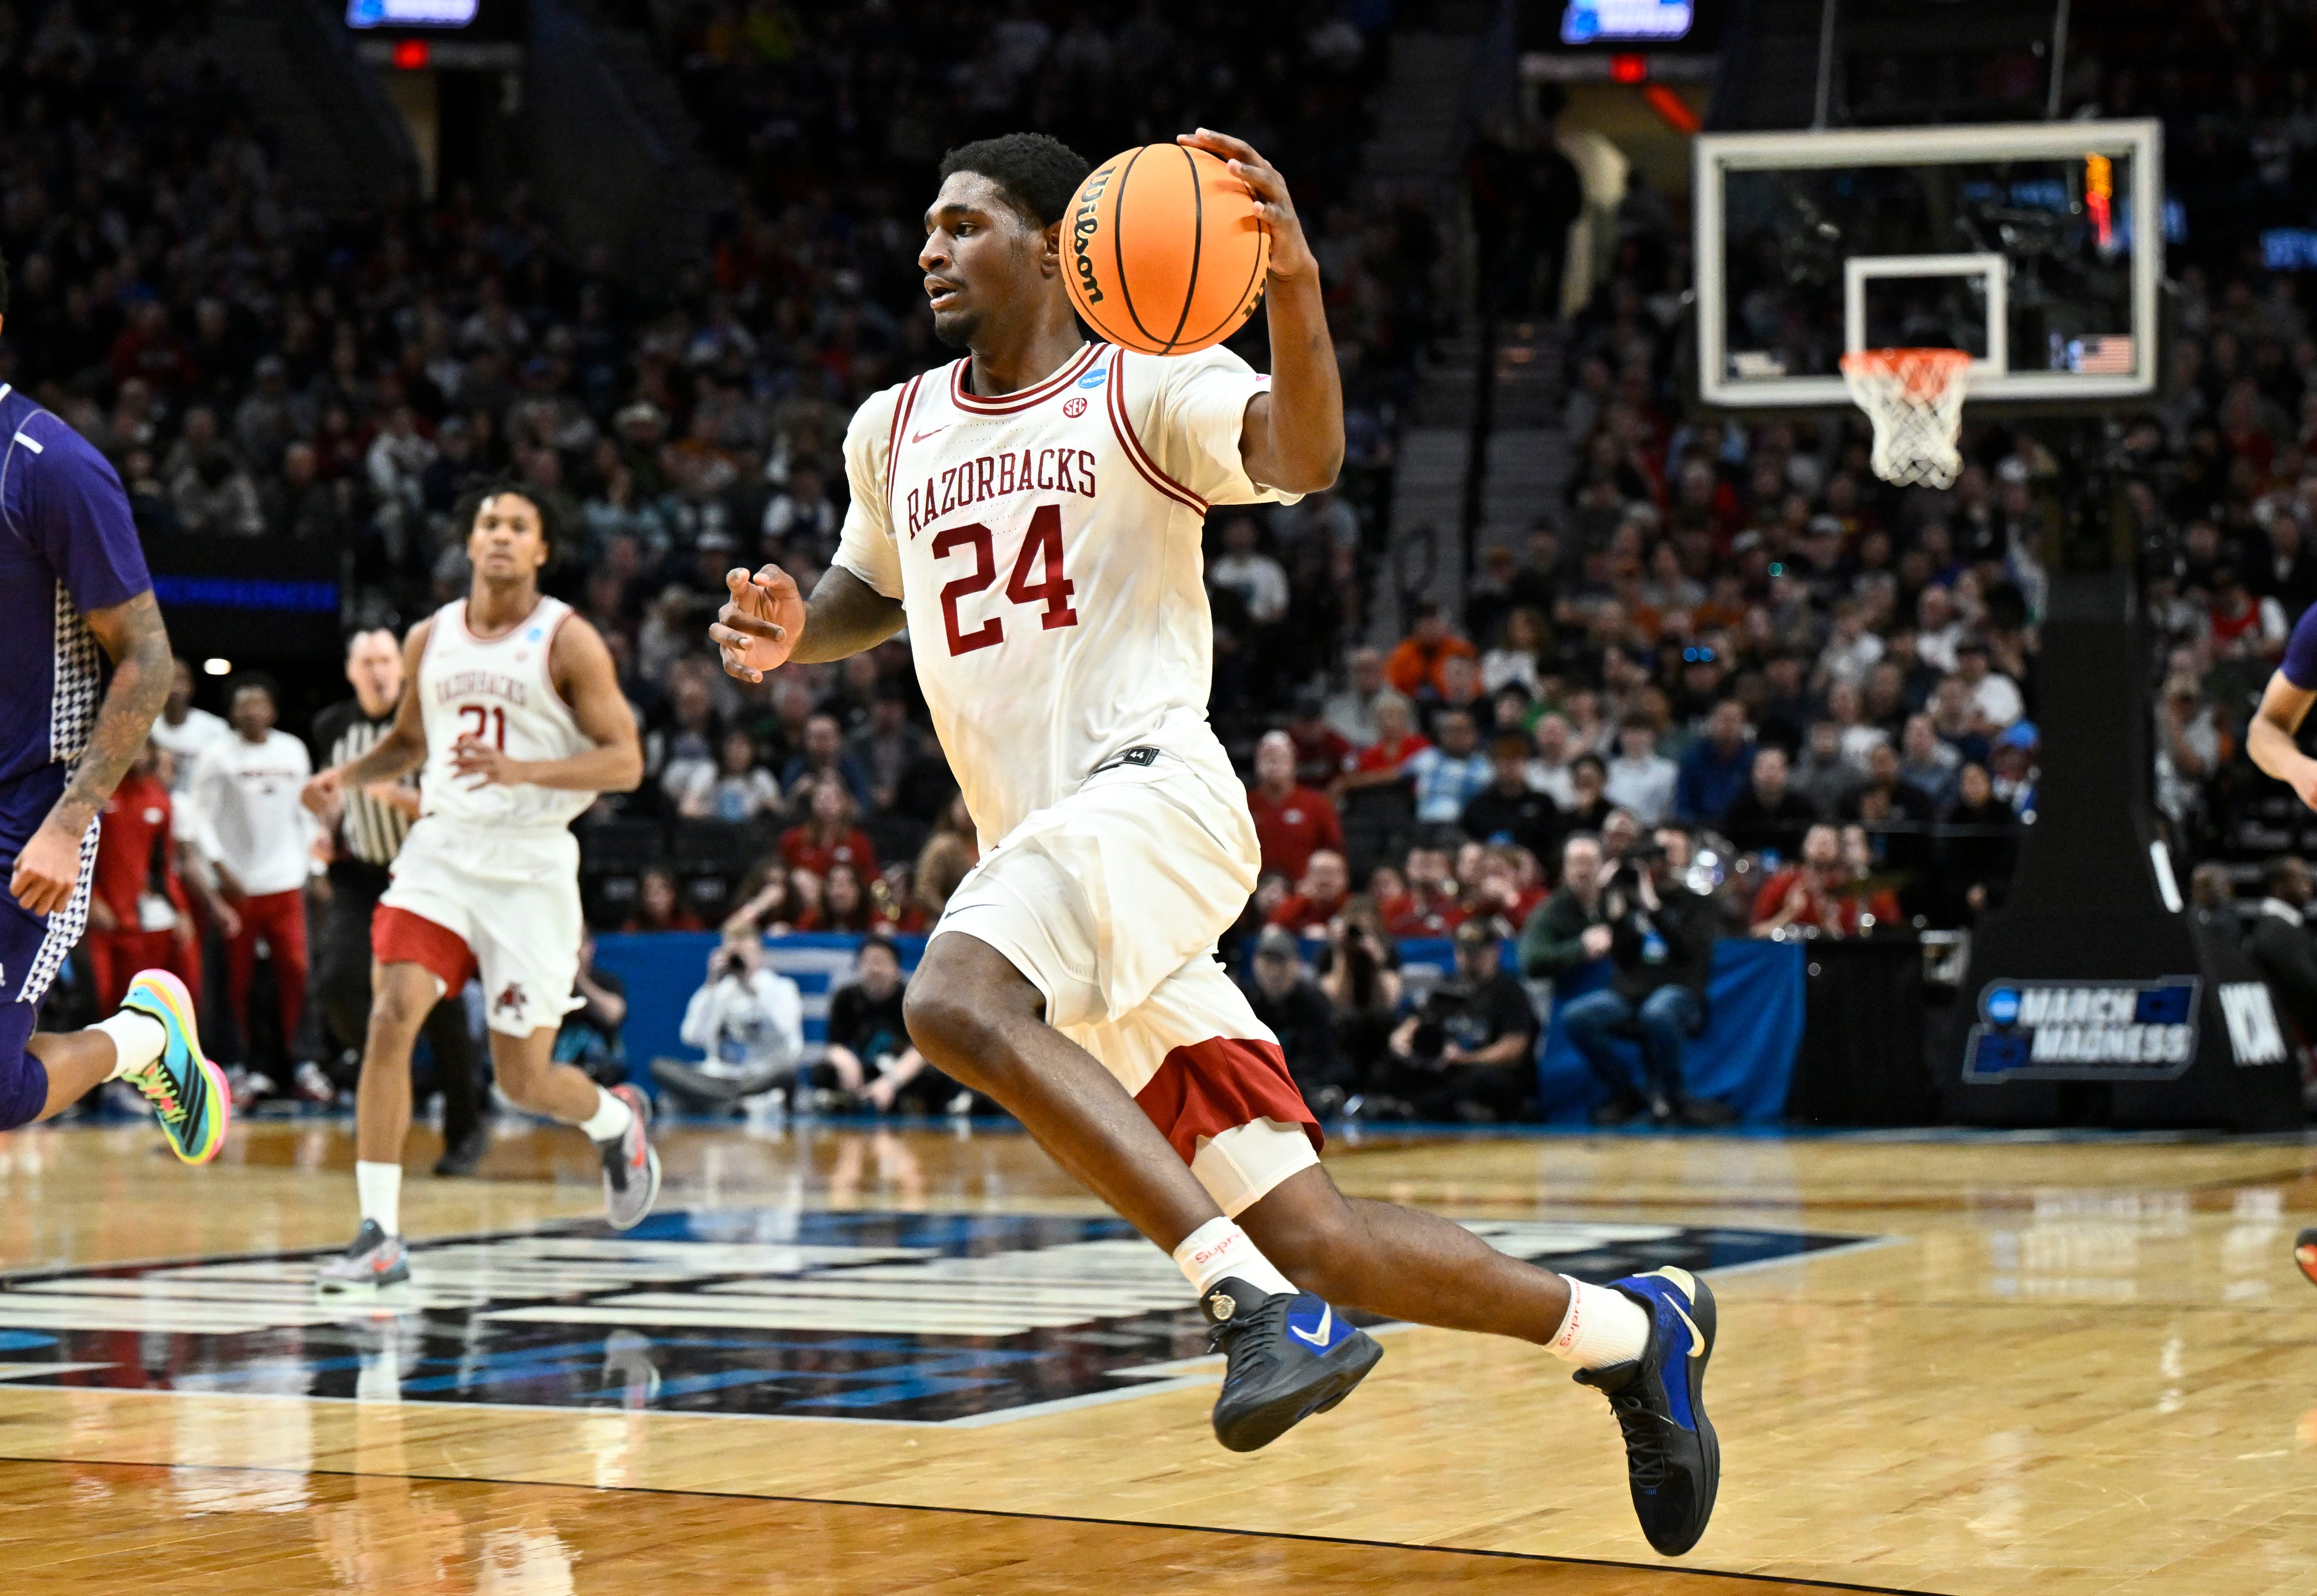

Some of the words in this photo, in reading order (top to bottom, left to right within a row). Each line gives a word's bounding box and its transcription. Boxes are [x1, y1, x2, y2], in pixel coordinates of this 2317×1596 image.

[1074, 166, 1117, 306] Wilson
[1081, 374, 1106, 384] NCAA
[1064, 398, 1086, 416] SEC
[907, 448, 1095, 541] RAZORBACKS
[931, 504, 1078, 657] 24
[458, 704, 505, 751] 21
[1130, 751, 1144, 759] 44
